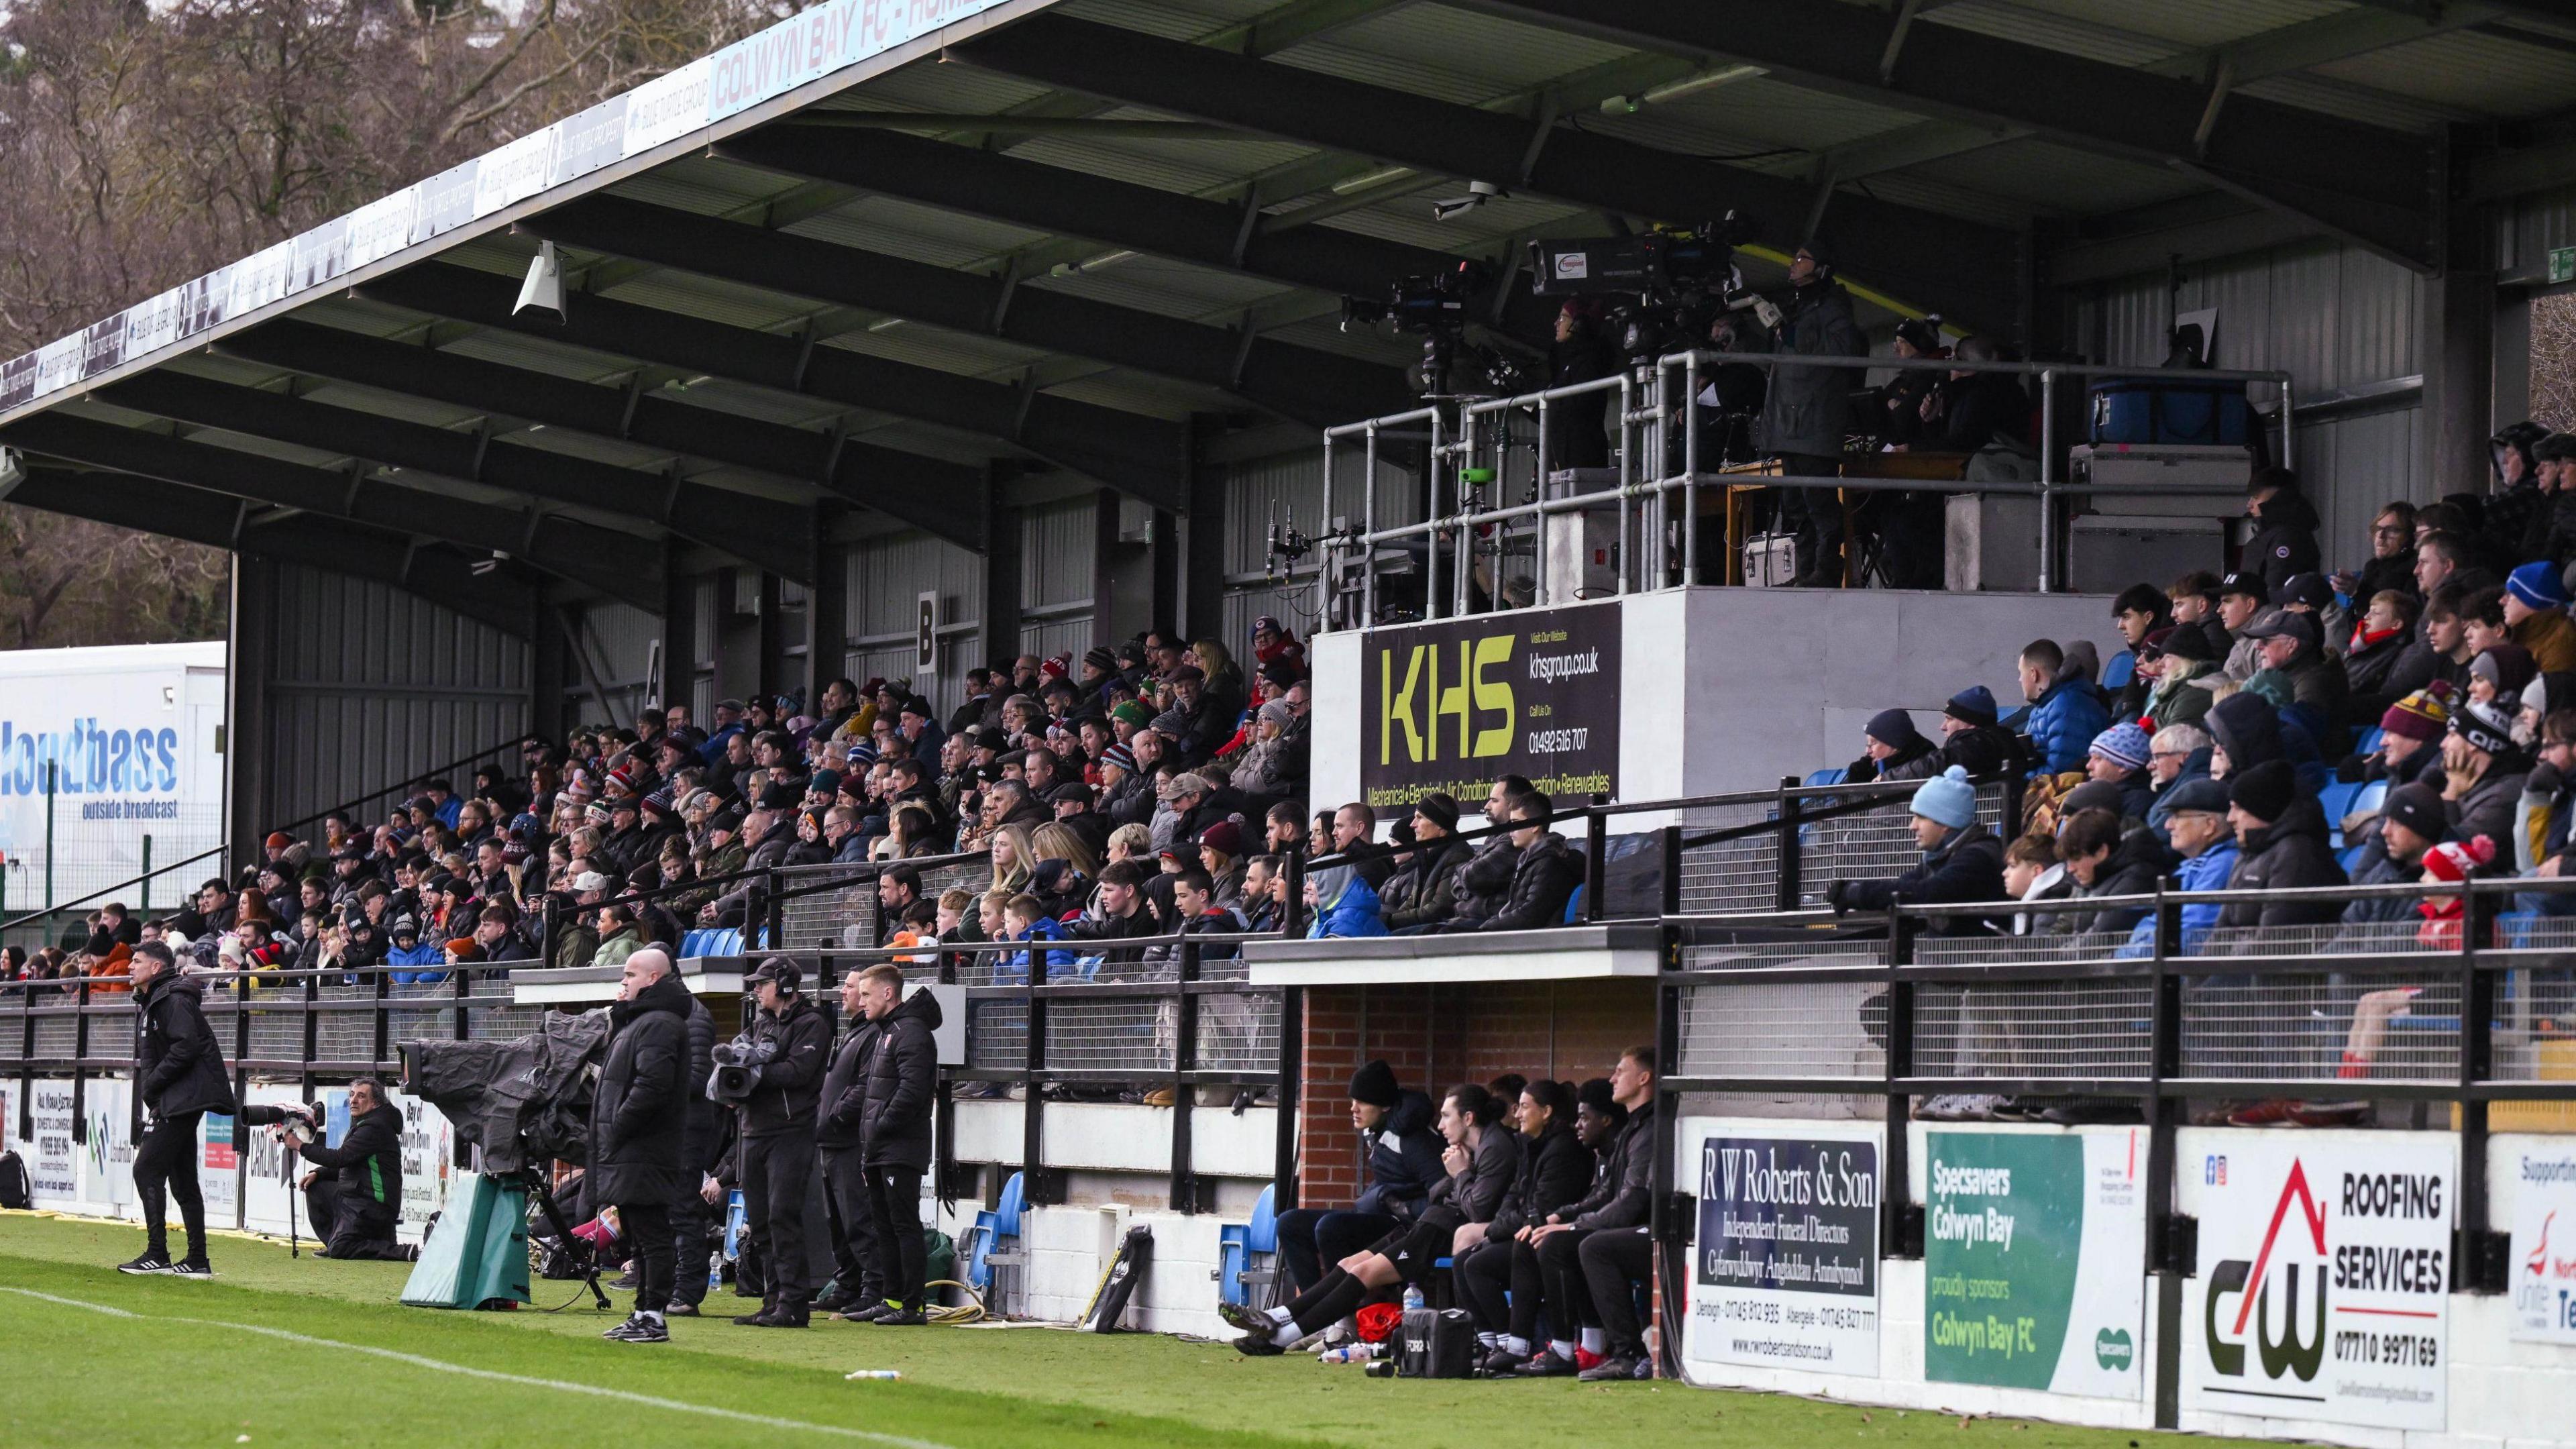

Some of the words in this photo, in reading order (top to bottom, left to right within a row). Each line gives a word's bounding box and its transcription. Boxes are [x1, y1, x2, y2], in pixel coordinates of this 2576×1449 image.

[715, 23, 804, 109] COLWYN
[809, 0, 856, 68] BAY
[861, 0, 888, 48] FC
[642, 98, 658, 132] BLUE
[659, 88, 682, 125] TURTLE
[683, 76, 708, 114] GROUP
[561, 134, 574, 163] BLUE
[575, 126, 593, 157] TURTLE
[594, 113, 625, 149] PROPERTY
[920, 600, 933, 666] B
[1530, 632, 1541, 644] Visit
[1542, 631, 1550, 643] Our
[1551, 630, 1568, 642] Website
[1530, 646, 1599, 684] khsgroup.co.uk
[1381, 635, 1515, 765] KHS
[1529, 704, 1538, 717] Call
[1538, 705, 1544, 716] Us
[1545, 704, 1551, 716] On
[1, 717, 177, 796] loudbass
[1529, 731, 1555, 754] 01492
[1556, 729, 1570, 752] 516
[1572, 728, 1588, 751] 707
[1367, 783, 1404, 807] Mechanical
[1446, 780, 1456, 801] Air
[1457, 778, 1497, 802] Conditioni
[1562, 771, 1609, 798] Renewables
[83, 799, 121, 820] outside
[124, 798, 178, 820] broadcast
[58, 1092, 74, 1111] ELECTRICA
[407, 1102, 415, 1126] Bay
[416, 1102, 423, 1122] of
[37, 1117, 52, 1130] DOMESTIC
[55, 1118, 72, 1131] COMMERCIA
[399, 1128, 415, 1152] olwyn
[417, 1129, 430, 1150] Town
[251, 1129, 280, 1179] CARLING
[403, 1154, 421, 1176] Council
[2522, 1156, 2576, 1187] Supportin
[410, 1186, 419, 1201] Local
[419, 1187, 432, 1201] Football
[1703, 1148, 1717, 1200] R
[1721, 1148, 1741, 1201] W
[1743, 1147, 1811, 1205] Roberts
[1817, 1150, 1835, 1205] &
[1839, 1151, 1874, 1208] Son
[1933, 1159, 2010, 1203] Specsavers
[2342, 1172, 2441, 1219] ROOFING
[1723, 1211, 1776, 1244] Independent
[1777, 1214, 1808, 1242] Funeral
[1809, 1215, 1849, 1244] Directors
[1933, 1203, 1984, 1250] Colwyn
[1986, 1206, 2015, 1252] Bay
[1707, 1249, 1764, 1284] Cyfarwyddwyr
[1765, 1252, 1811, 1286] Angladdau
[2334, 1245, 2443, 1294] SERVICES
[1932, 1272, 1966, 1302] proudly
[1968, 1278, 2010, 1303] sponsors
[1697, 1299, 1719, 1322] Denbigh
[1725, 1301, 1746, 1321] 01745
[1750, 1300, 1762, 1320] 812
[1764, 1303, 1779, 1324] 935
[1786, 1306, 1815, 1330] Abergele
[1821, 1307, 1843, 1329] 01745
[1732, 1336, 1833, 1360] www.rwrobertsandson.co.uk
[1933, 1310, 1985, 1357] Colwyn
[1987, 1314, 2014, 1360] Bay
[2017, 1317, 2036, 1354] FC
[2335, 1330, 2377, 1363] 07710
[2383, 1336, 2436, 1368] 997169
